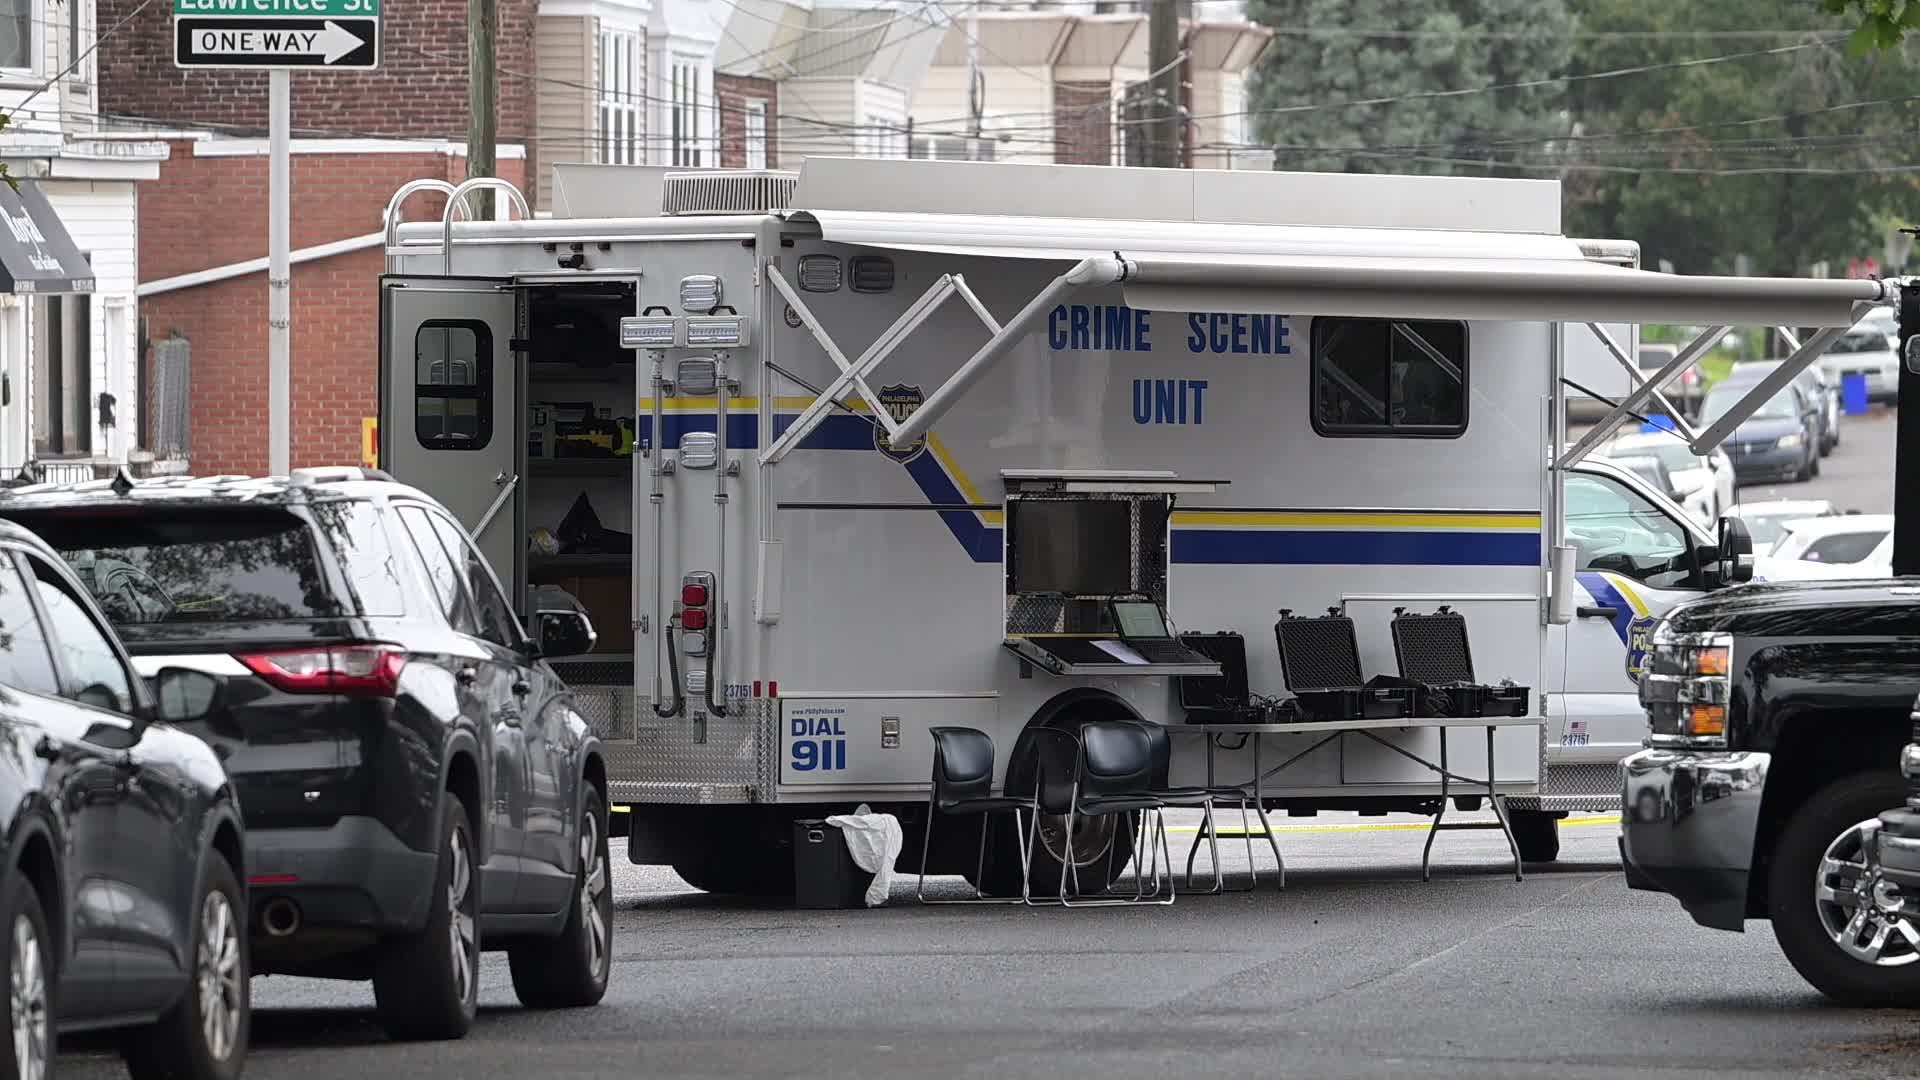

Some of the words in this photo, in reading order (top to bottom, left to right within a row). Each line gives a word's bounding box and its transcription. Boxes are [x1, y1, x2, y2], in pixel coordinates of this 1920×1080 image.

[180, 0, 328, 10] Lawrence
[343, 0, 373, 11] St
[201, 32, 254, 51] ONE
[263, 32, 317, 51] WAY
[1049, 304, 1151, 351] CRIME
[1187, 312, 1291, 354] SCENE
[1132, 379, 1208, 425] UNIT
[724, 684, 752, 698] 237151
[791, 718, 846, 737] DIAL
[1562, 734, 1590, 747] 237151
[791, 740, 846, 771] 911
